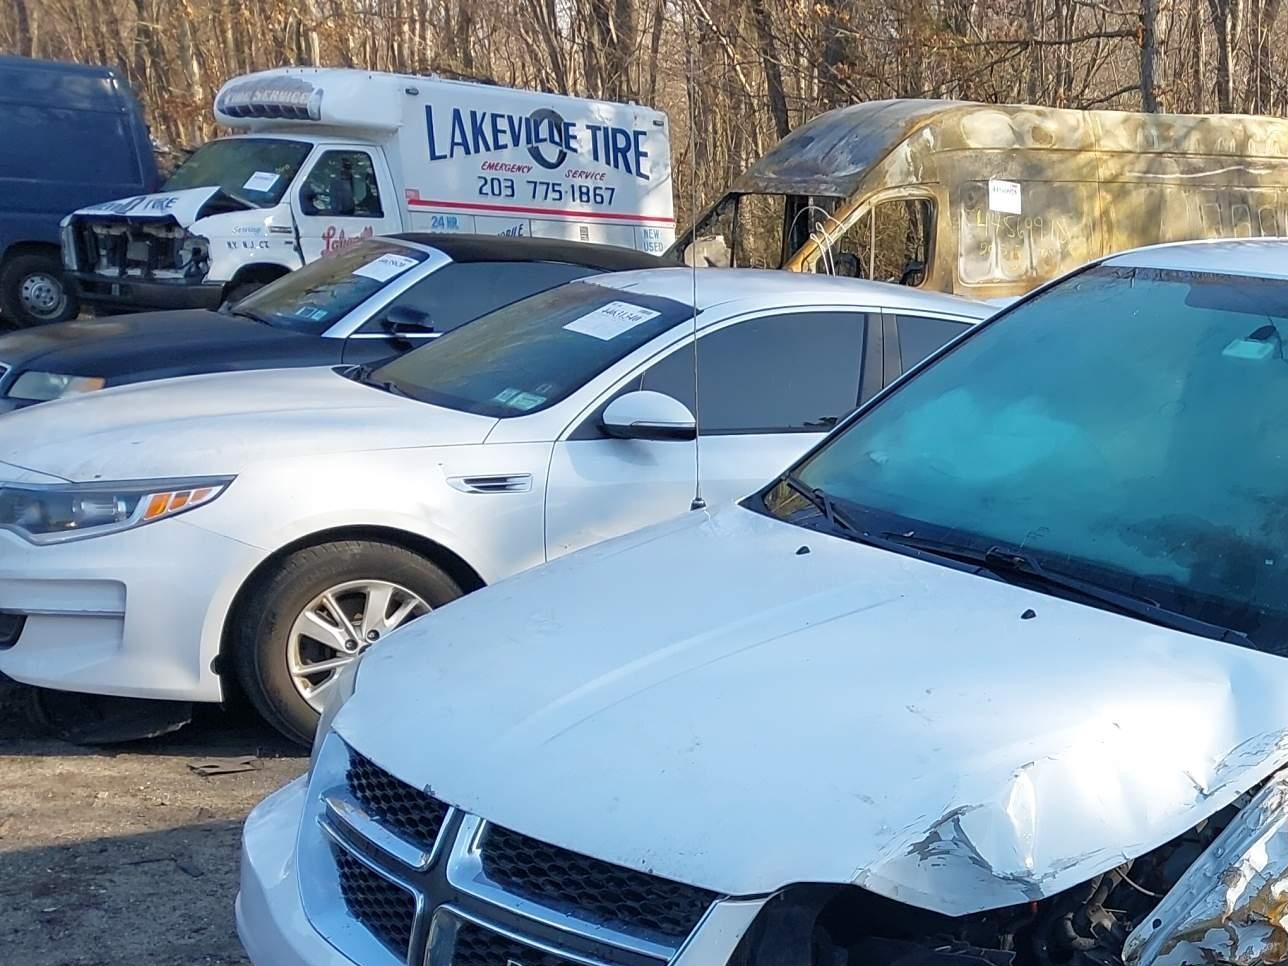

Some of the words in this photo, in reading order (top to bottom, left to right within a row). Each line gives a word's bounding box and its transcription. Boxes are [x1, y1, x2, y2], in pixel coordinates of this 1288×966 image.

[425, 104, 578, 161] LAKEVILLE
[586, 123, 650, 181] TIRE
[481, 160, 533, 174] EMERGENCY
[565, 169, 606, 181] SERVICE
[478, 176, 515, 197] 203
[431, 215, 445, 227] 24
[643, 228, 660, 239] NEW
[643, 241, 664, 252] USED
